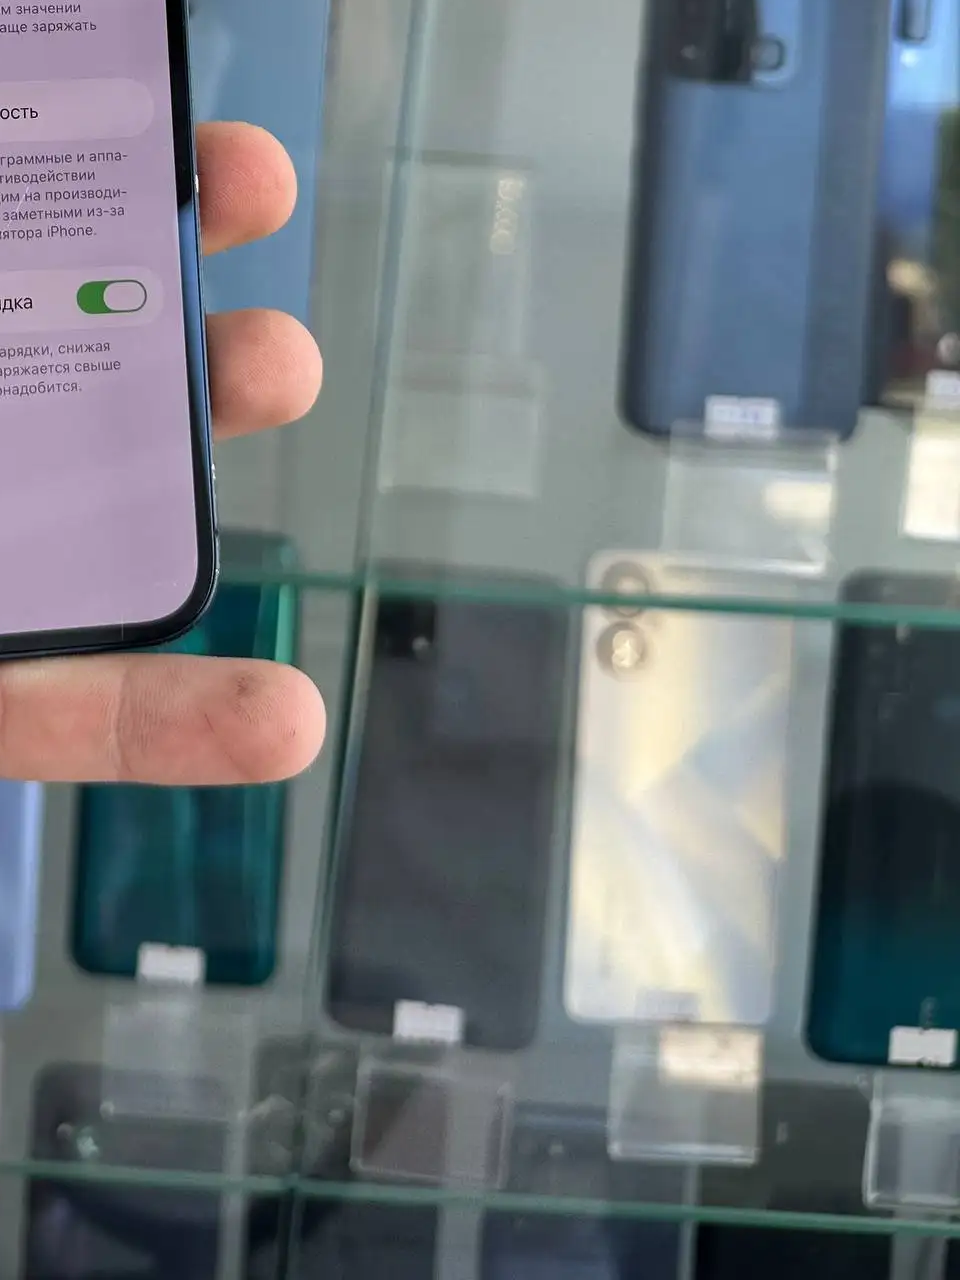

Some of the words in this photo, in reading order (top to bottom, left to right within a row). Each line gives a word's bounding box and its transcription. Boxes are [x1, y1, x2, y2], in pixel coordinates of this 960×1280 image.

[15, 4, 81, 15] значении
[31, 21, 97, 34] заряжать
[76, 153, 85, 163] и
[89, 151, 128, 163] аппа-
[24, 191, 41, 202] на
[45, 188, 128, 203] производи-
[2, 208, 83, 222] заметными
[86, 206, 125, 218] из-за
[47, 224, 97, 238] iPhone.
[58, 342, 111, 354] снижая
[74, 360, 121, 373] свыше
